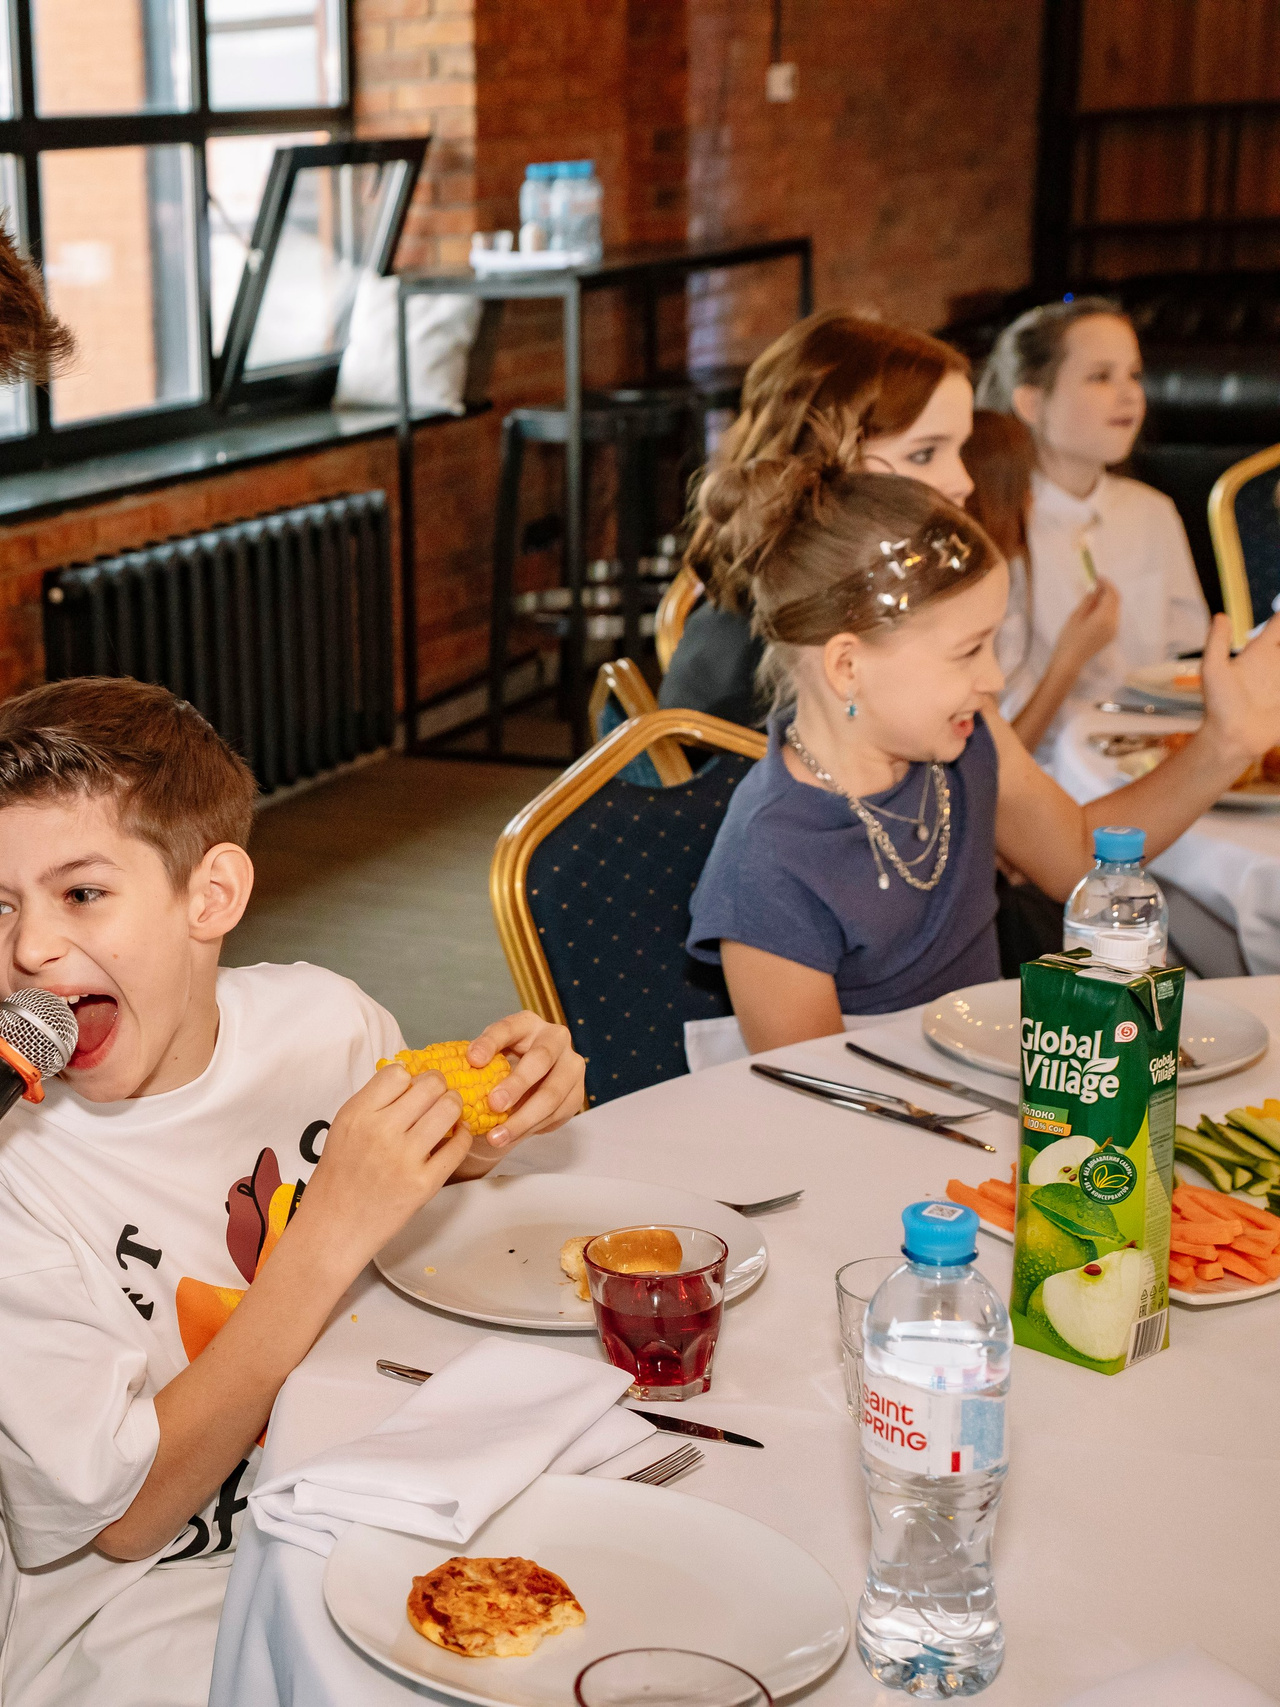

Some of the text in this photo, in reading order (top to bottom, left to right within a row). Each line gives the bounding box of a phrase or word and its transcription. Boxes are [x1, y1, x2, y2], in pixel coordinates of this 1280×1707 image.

[1021, 1017, 1103, 1060] Global
[1022, 1049, 1119, 1104] Village
[1149, 1050, 1173, 1072] Global
[1151, 1065, 1176, 1085] Village
[862, 1404, 927, 1451] PRING
